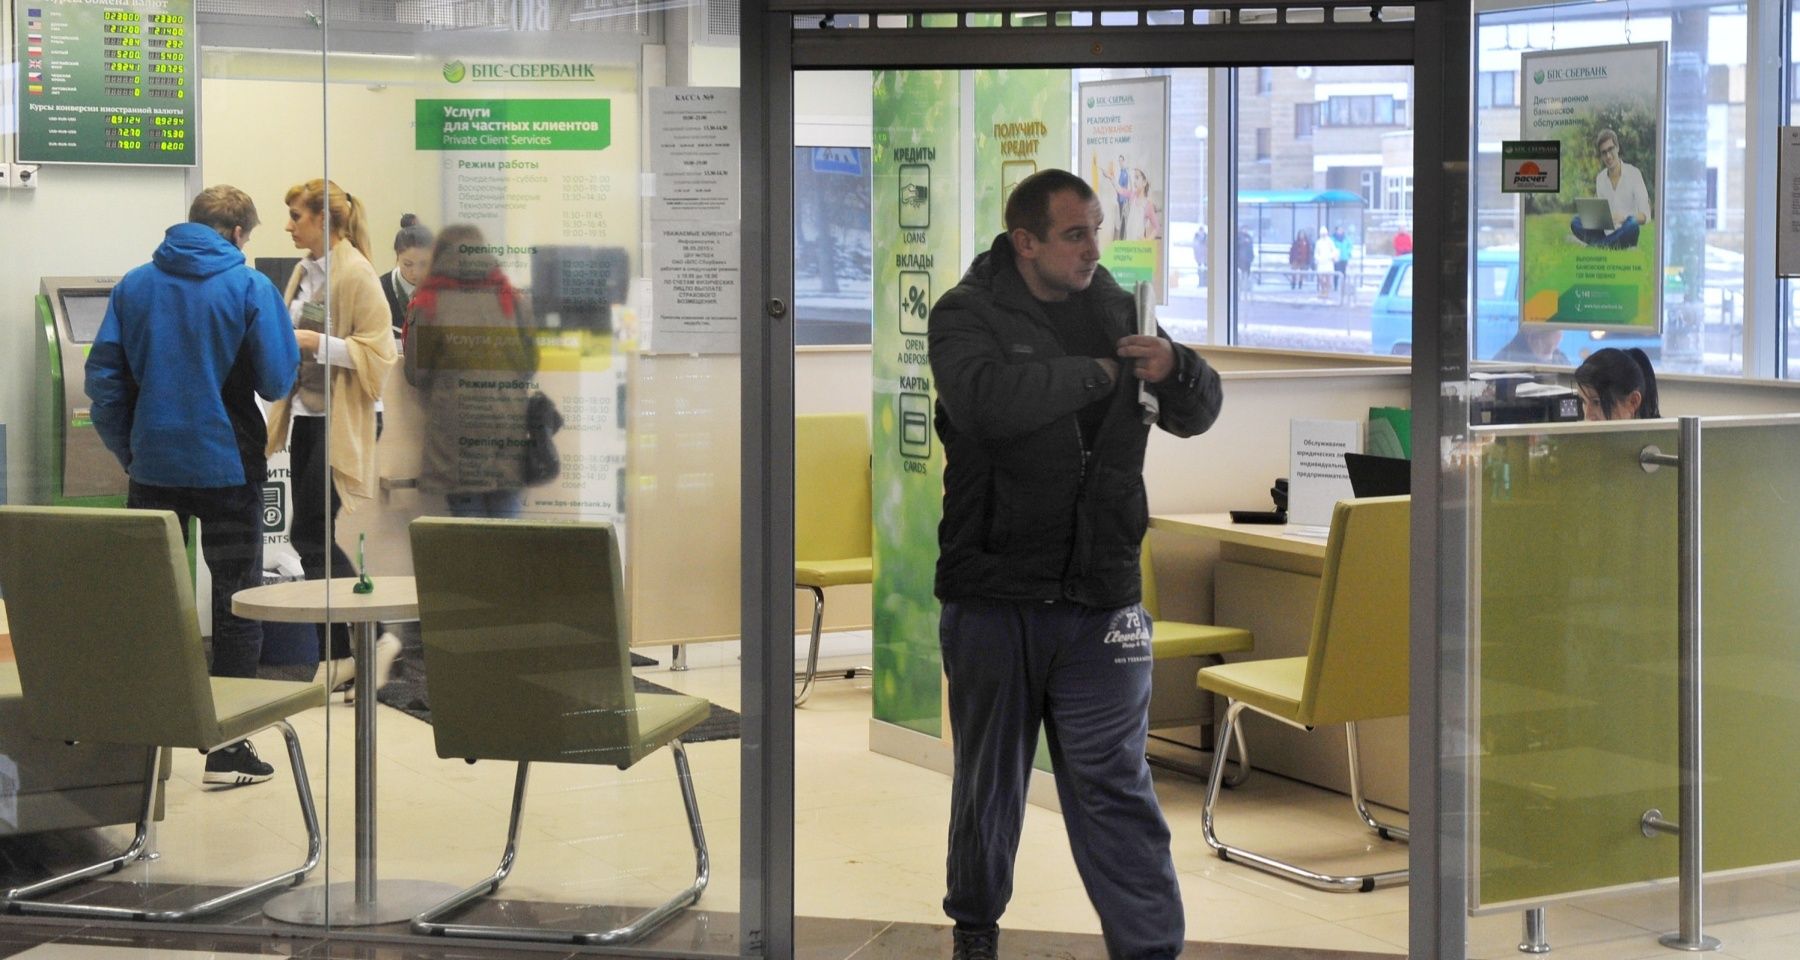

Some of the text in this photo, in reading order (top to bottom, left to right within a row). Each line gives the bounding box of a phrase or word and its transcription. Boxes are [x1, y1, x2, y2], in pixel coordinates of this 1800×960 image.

[472, 64, 594, 77] БПС-СБЕРБАНК
[1547, 66, 1608, 79] БПС-СБЕРБАНК
[1533, 95, 1589, 105] Дистанционное
[29, 103, 54, 112] Курсы
[56, 105, 98, 113] конверсии
[100, 106, 152, 114] иностранной
[443, 106, 490, 120] Услуги
[1533, 107, 1575, 116] банковское
[1087, 115, 1121, 124] РЕАЛИЗУЙТЕ
[443, 121, 599, 133] для частных клиентов
[994, 121, 1047, 139] ПОЛУЧИТЬ
[443, 134, 552, 145] Private Client Services
[1000, 139, 1039, 157] КРЕДИТ
[893, 147, 936, 162] КРЕДИТЫ
[458, 160, 538, 170] Режим работы
[903, 232, 926, 244] LOANS
[458, 244, 537, 256] Opening hours
[896, 254, 933, 268] ВКЛАДЫ
[905, 338, 924, 350] OPEN
[897, 352, 929, 366] A DEPOSI
[458, 379, 539, 390] Режим работы
[900, 376, 929, 390] КАРТЫ
[458, 437, 504, 449] Opening
[1303, 439, 1346, 447] Обслуживание
[1297, 451, 1335, 459] юридических
[904, 460, 927, 474] CARDS
[1300, 461, 1347, 469] индивидуальны
[1297, 471, 1349, 479] предпринимателе
[263, 535, 290, 544] ENTS
